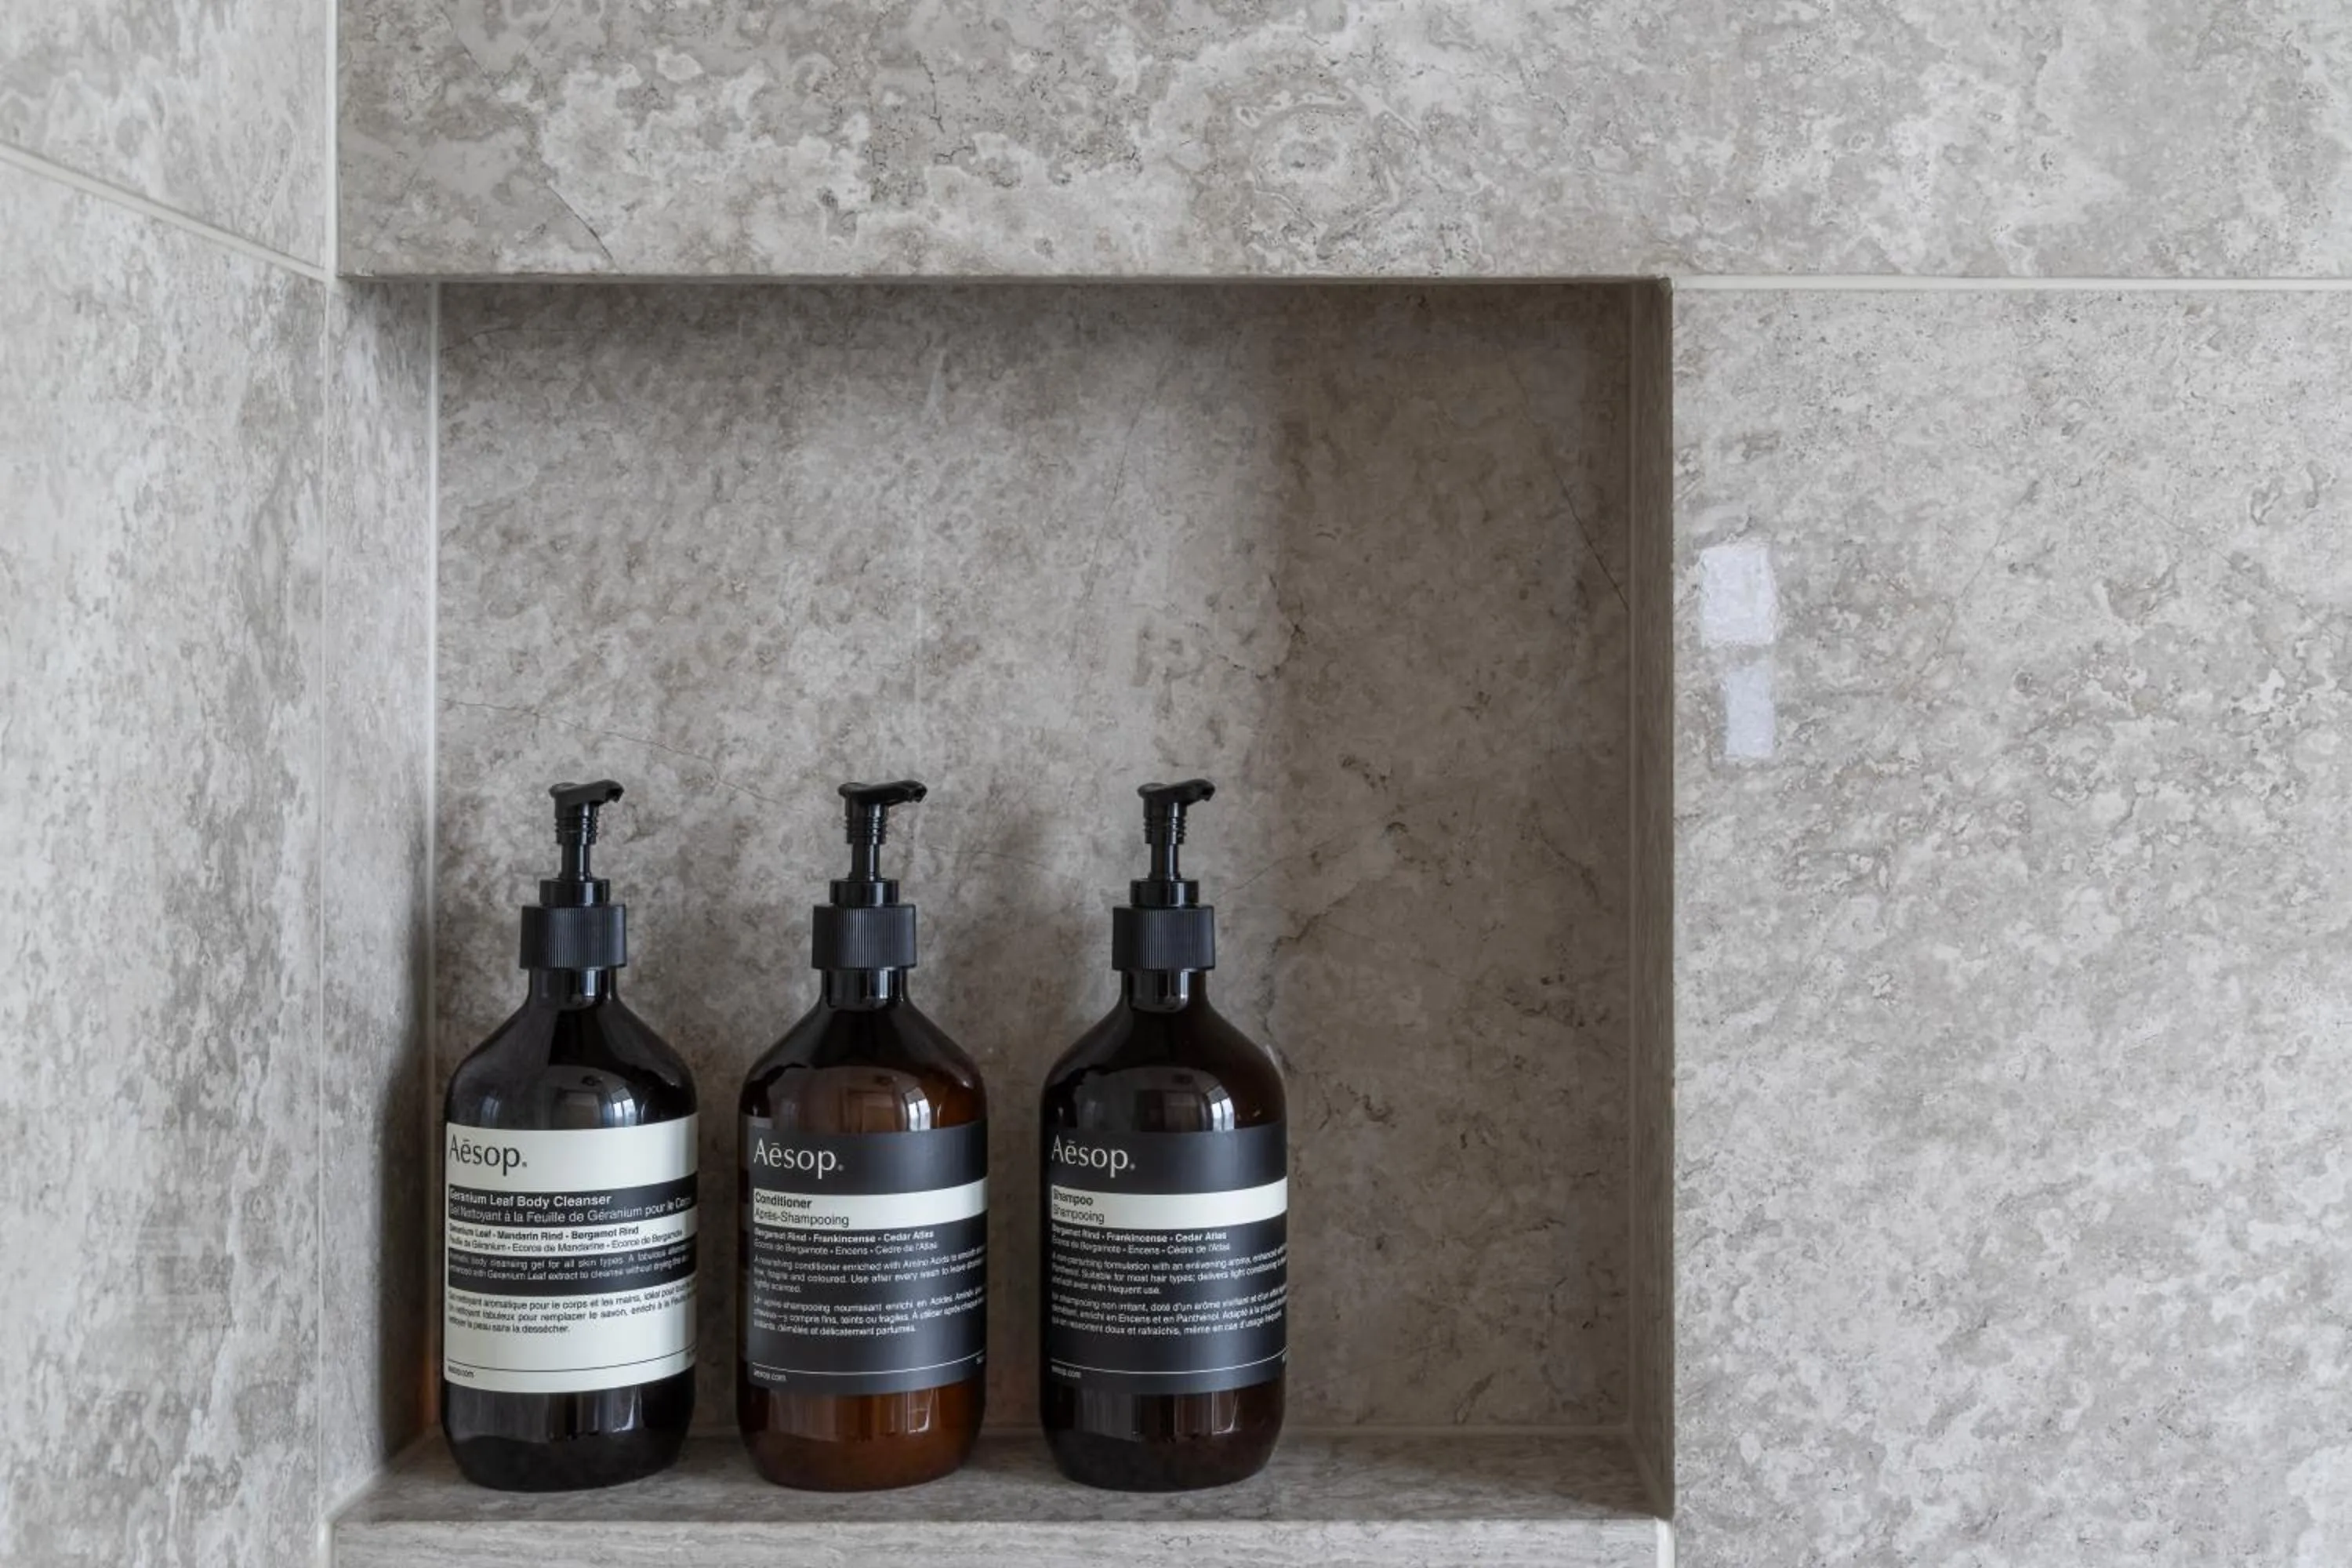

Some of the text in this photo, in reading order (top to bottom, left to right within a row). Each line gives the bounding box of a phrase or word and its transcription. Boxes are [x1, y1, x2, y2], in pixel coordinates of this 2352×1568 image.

[753, 1138, 844, 1179] Aēsop.
[490, 1194, 514, 1207] Leaf
[517, 1196, 550, 1210] Body
[553, 1196, 612, 1207] Cleanser
[755, 1192, 812, 1209] Conditioner
[514, 1211, 524, 1222] la
[526, 1211, 565, 1222] Feuille
[568, 1210, 584, 1223] de
[587, 1206, 643, 1221] Géranium
[645, 1203, 666, 1218] pour
[474, 1226, 639, 1241] Leaf Mandarin Rind Bergamot Rind
[813, 1233, 876, 1243] Frankincense
[884, 1233, 911, 1243] Cedar
[1106, 1232, 1167, 1243] Frankincense
[1175, 1233, 1203, 1243] Cedar
[543, 1243, 556, 1253] de
[558, 1242, 604, 1253] Mandarine
[835, 1246, 868, 1255] Encens
[1127, 1244, 1160, 1255] Encens
[531, 1259, 545, 1270] gel
[549, 1259, 559, 1269] for
[564, 1258, 575, 1268] all
[579, 1258, 597, 1268] skin
[795, 1261, 840, 1271] conditioner
[884, 1261, 901, 1270] with
[902, 1259, 929, 1269] Amino
[1104, 1260, 1150, 1271] formulation
[1152, 1261, 1171, 1271] with
[1172, 1262, 1183, 1271] an
[528, 1271, 546, 1280] Leaf
[548, 1271, 578, 1280] extract
[579, 1270, 588, 1279] to
[851, 1274, 869, 1283] Use
[871, 1273, 892, 1283] after
[895, 1272, 918, 1282] every
[1114, 1272, 1126, 1282] for
[1127, 1274, 1149, 1283] most
[1150, 1274, 1167, 1283] hair
[1107, 1283, 1142, 1295] frequent
[529, 1301, 550, 1312] pour
[550, 1300, 560, 1309] le
[562, 1300, 588, 1310] corps
[590, 1298, 598, 1308] et
[601, 1298, 613, 1306] les
[885, 1301, 913, 1311] enrichi
[916, 1300, 927, 1308] en
[518, 1312, 538, 1322] pour
[540, 1311, 586, 1323] remplacer
[589, 1310, 598, 1320] le
[1152, 1315, 1161, 1323] et
[1163, 1316, 1175, 1324] en
